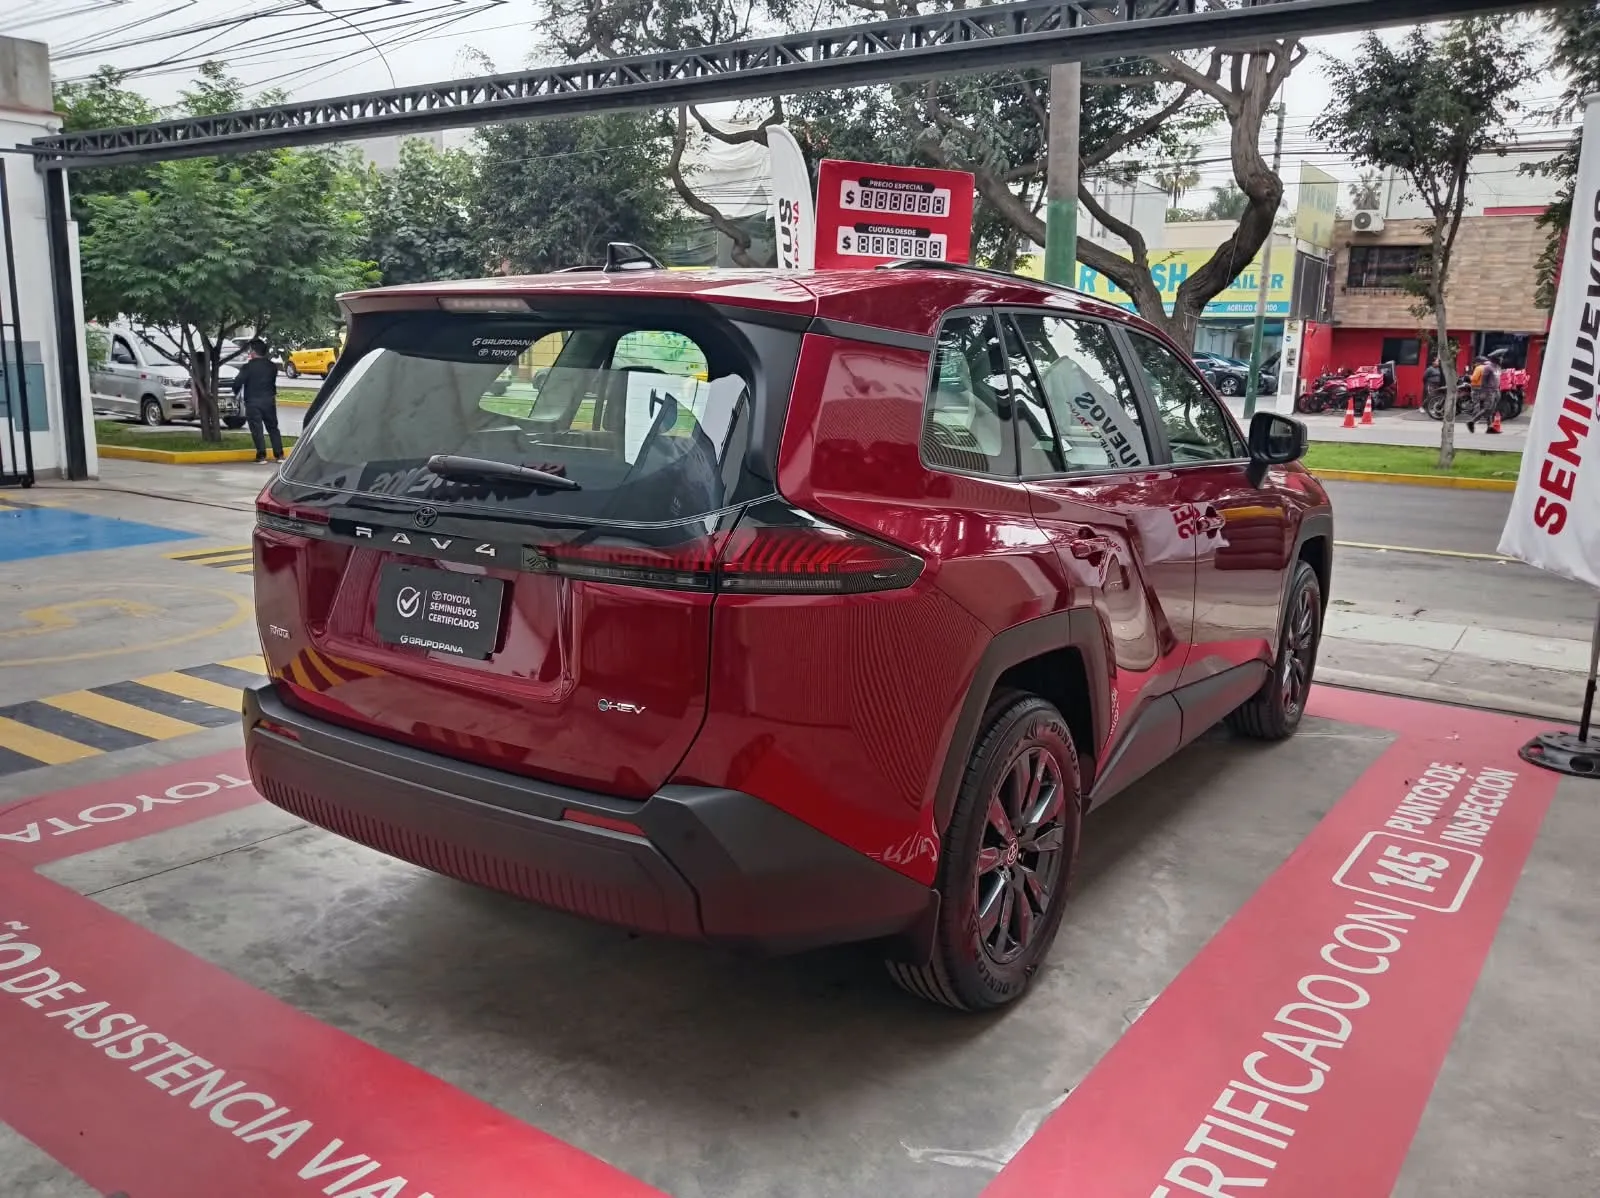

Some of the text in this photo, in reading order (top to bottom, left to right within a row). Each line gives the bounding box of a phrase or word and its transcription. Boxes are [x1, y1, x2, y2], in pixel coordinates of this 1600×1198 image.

[869, 180, 924, 191] PRECIO ESPECIAL
[845, 190, 855, 204] $
[868, 225, 917, 236] CUOTAS DESDE
[842, 236, 851, 250] $
[491, 349, 518, 357] TOYOTA
[355, 526, 496, 557] RAV4
[443, 592, 471, 605] TOYOTA
[429, 601, 478, 618] SEMINUEVOS
[428, 612, 480, 630] CERTIFICADOS
[408, 637, 464, 654] GRUPOPANA
[1384, 762, 1467, 835] PUNTOS DE
[1440, 766, 1519, 848] INSPECCIÓN
[0, 773, 252, 843] TOYOTA
[1368, 844, 1450, 883] 145
[1150, 900, 1416, 1198] RTIFICADO CON
[0, 966, 86, 1009] DE
[45, 1001, 314, 1160] ASISTENCIA
